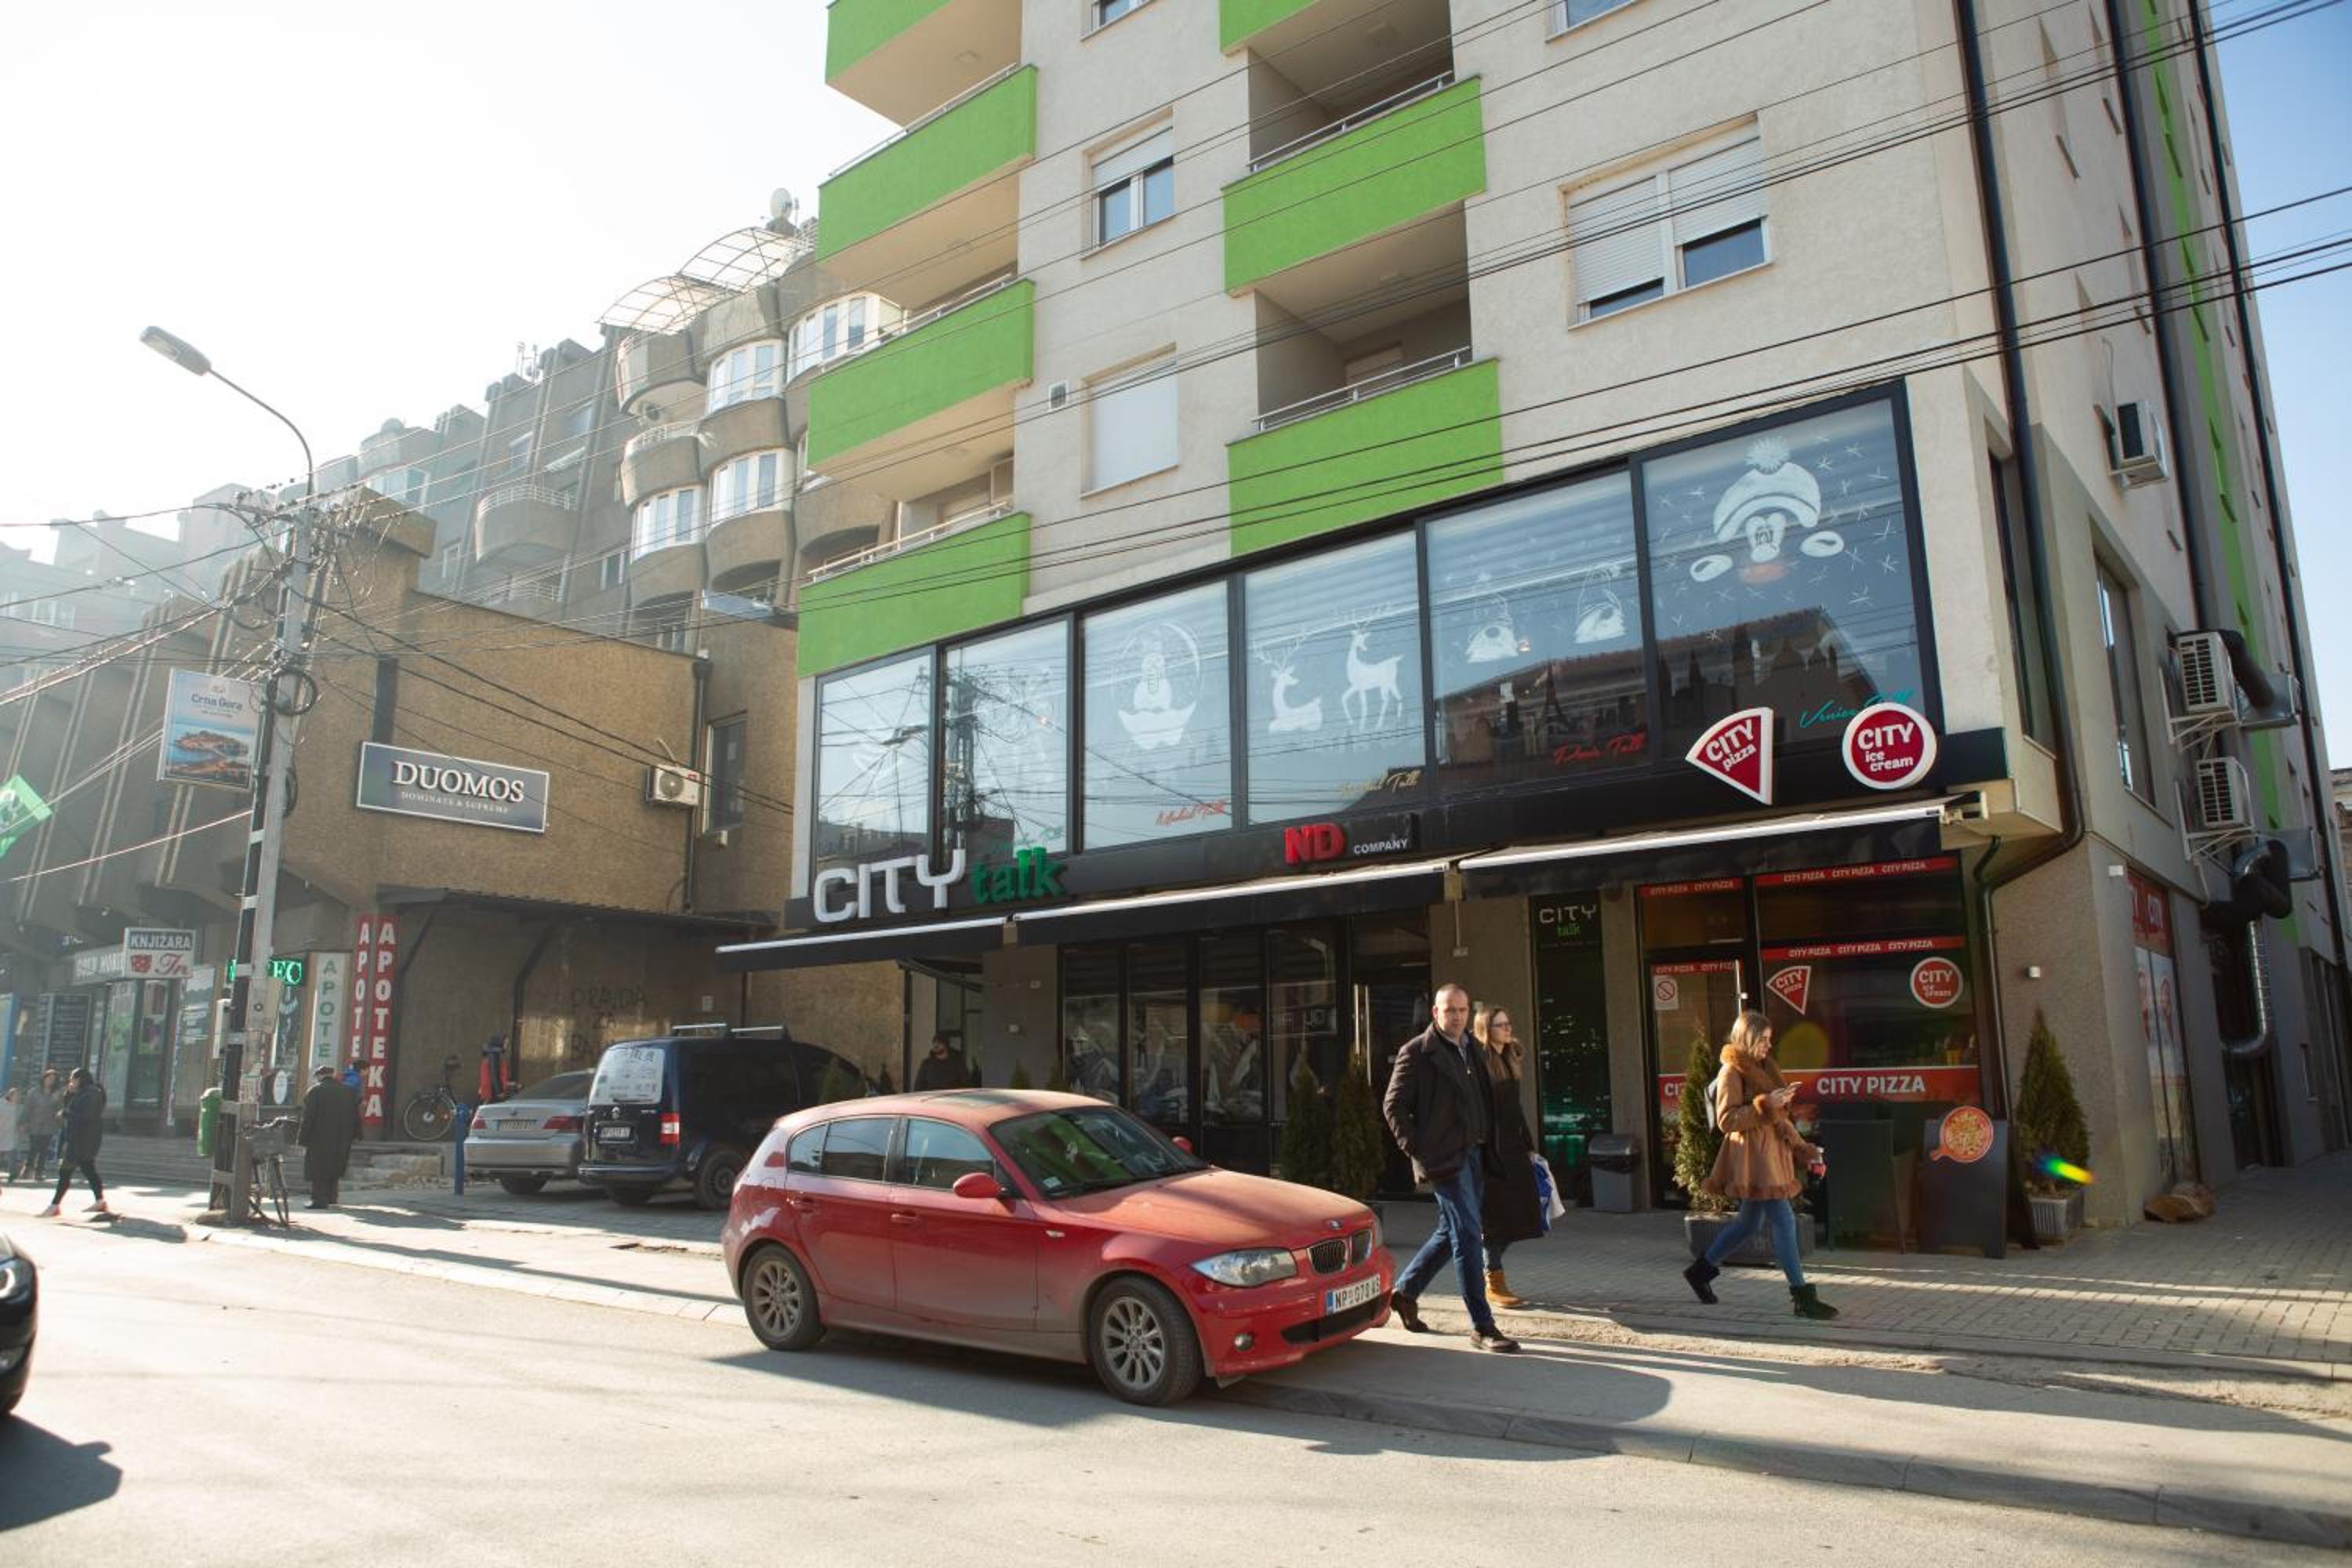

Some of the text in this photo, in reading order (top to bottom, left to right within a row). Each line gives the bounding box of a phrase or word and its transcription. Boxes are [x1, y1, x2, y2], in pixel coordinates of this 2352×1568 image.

[1706, 719, 1754, 761] CITY
[1857, 722, 1915, 750] CITY
[1723, 744, 1756, 772] pizza
[1865, 750, 1886, 763] ice
[1870, 756, 1914, 772] cream
[392, 760, 524, 804] DUOMOS
[1284, 822, 1408, 866] ND COMPANY
[1784, 862, 1926, 883] CITY PIZZA CITY PIZZA CITY PIZZA
[814, 847, 1065, 923] CITY talk
[1539, 904, 1597, 924] CITY
[1789, 940, 1933, 958] CITY PIZZA CITY PIZZA CITY PIZZA
[1776, 970, 1803, 989] CITY
[1918, 970, 1953, 984] CITY
[351, 923, 369, 1058] APOTE
[318, 959, 337, 1058] APOTE
[365, 923, 395, 1117] APOTEKA
[1664, 1083, 1679, 1096] CI
[1817, 1076, 1926, 1094] CITY PIZZA
